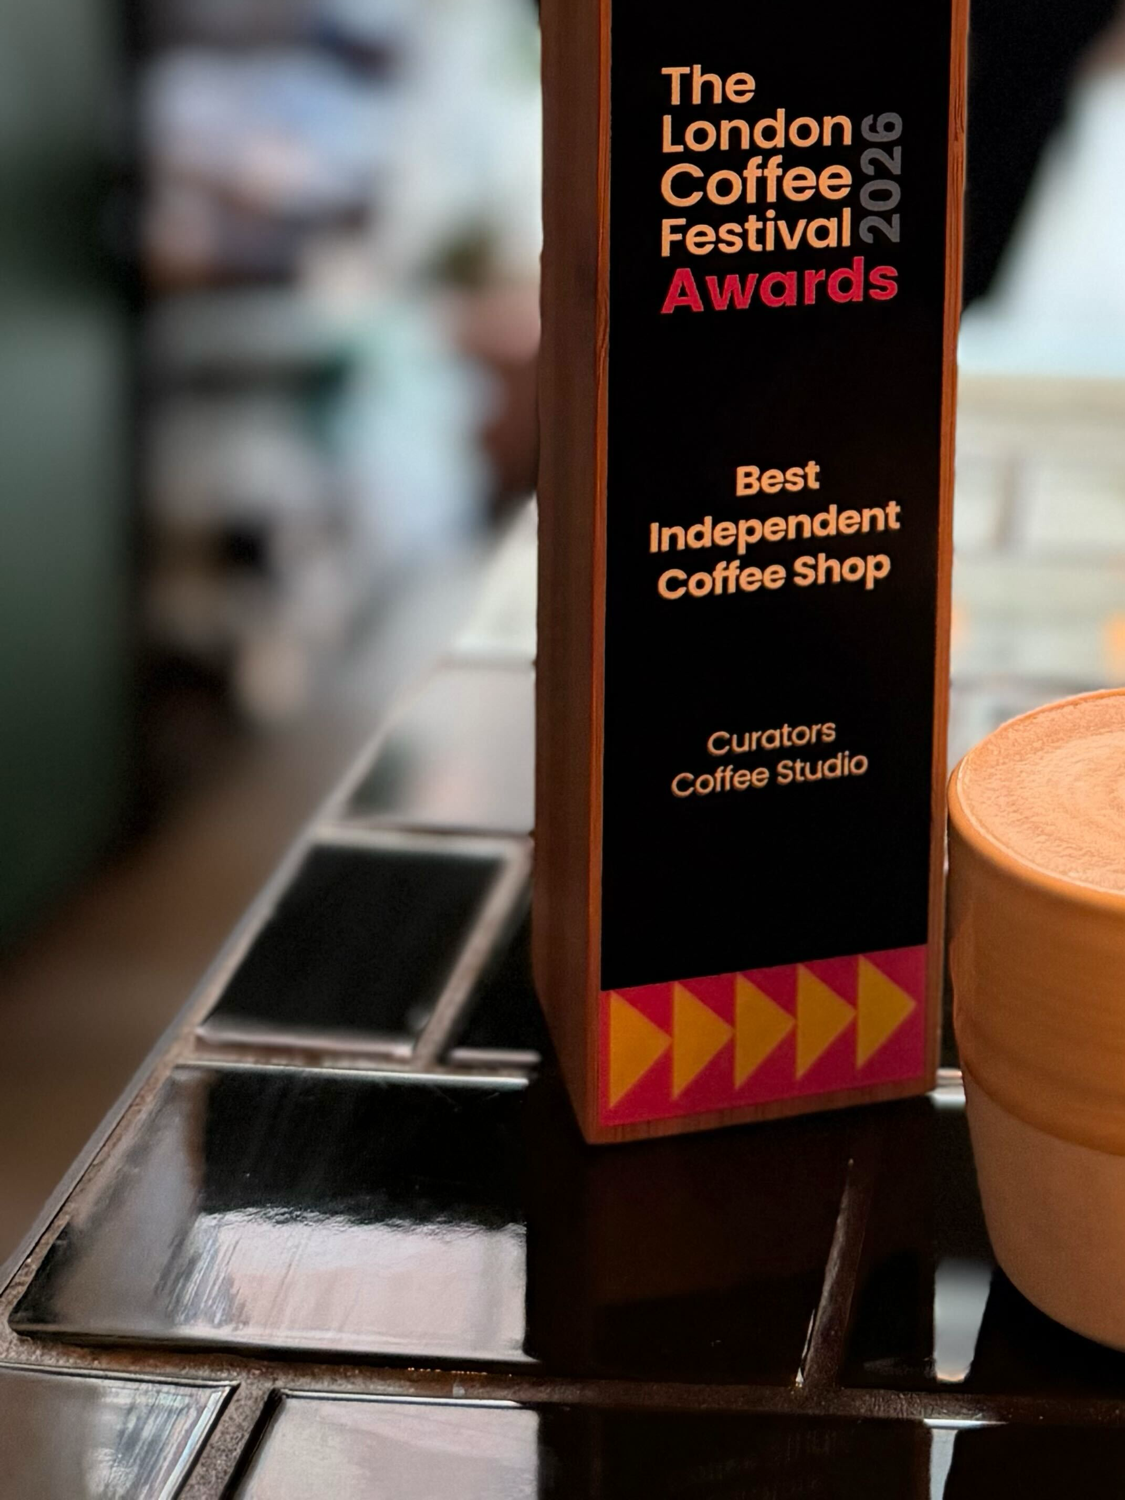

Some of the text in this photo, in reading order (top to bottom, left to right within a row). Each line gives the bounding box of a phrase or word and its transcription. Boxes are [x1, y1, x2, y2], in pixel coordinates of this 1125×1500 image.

[661, 64, 755, 105] The
[662, 108, 852, 153] London
[661, 154, 852, 207] Coffee
[859, 112, 902, 243] 2026
[661, 207, 851, 257] Festival
[660, 256, 898, 314] Awards
[736, 460, 820, 497] Best
[649, 500, 901, 555] Independent
[657, 553, 891, 600] Coffee Shop
[707, 722, 836, 756] Curators
[671, 751, 868, 797] Coffee Studio
